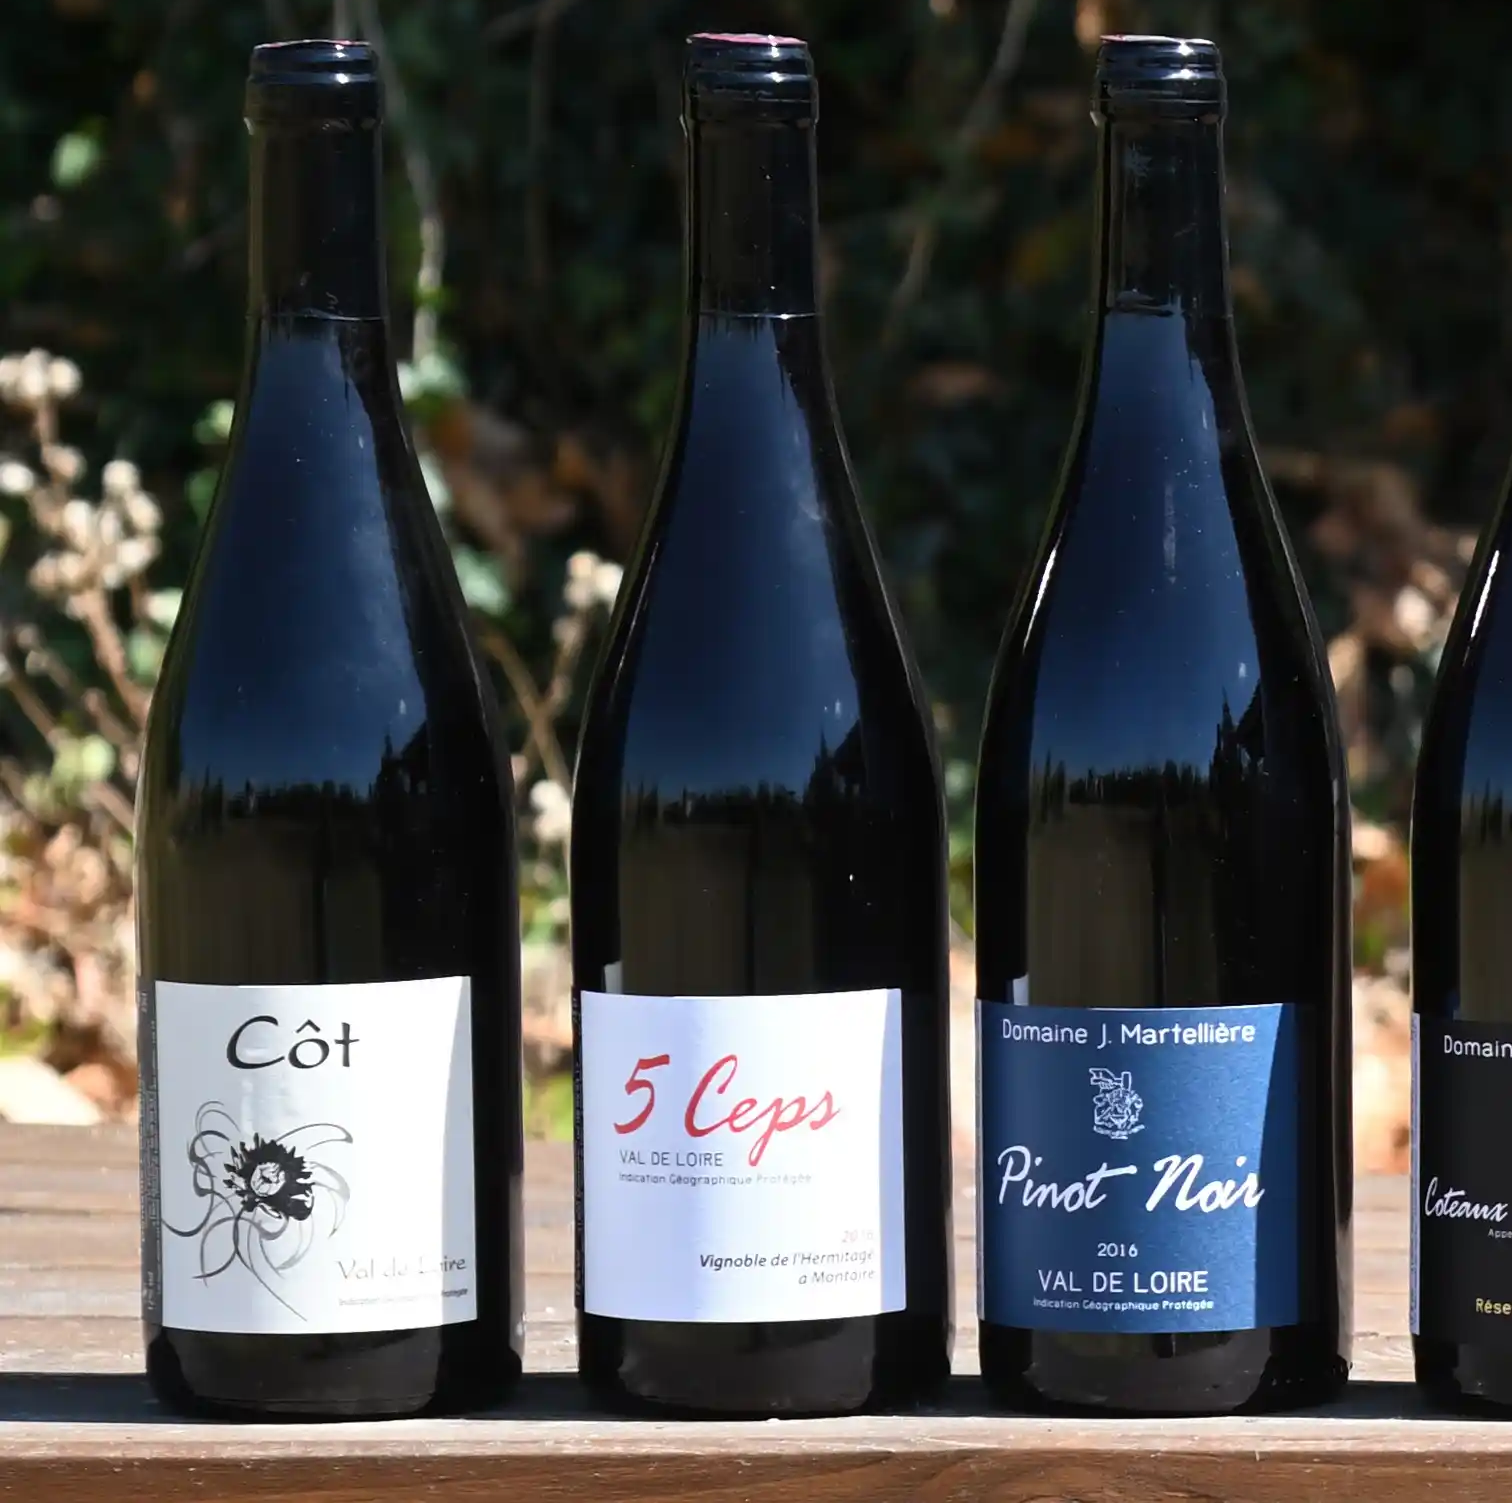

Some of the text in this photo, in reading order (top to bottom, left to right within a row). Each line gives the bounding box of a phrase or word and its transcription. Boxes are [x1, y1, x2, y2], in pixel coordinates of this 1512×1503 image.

[226, 1015, 359, 1069] Côt
[1002, 1019, 1256, 1049] Domaine J. Martellière
[613, 1054, 840, 1167] 5 Ceps
[619, 1151, 723, 1167] VAL DE LOIRE
[619, 1173, 666, 1184] Indication
[669, 1173, 751, 1186] Géographique
[998, 1146, 1264, 1212] Pinot Noir
[1424, 1177, 1508, 1221] Coteaux
[700, 1254, 766, 1271] Vignoble
[770, 1253, 789, 1267] de
[1098, 1244, 1138, 1257] 2016
[335, 1258, 374, 1280] Val
[416, 1255, 467, 1274] Lire
[812, 1269, 875, 1284] Montoire
[1038, 1270, 1208, 1293] VAL DE LOIRE
[1033, 1298, 1214, 1311] Indication Géographique Protégée
